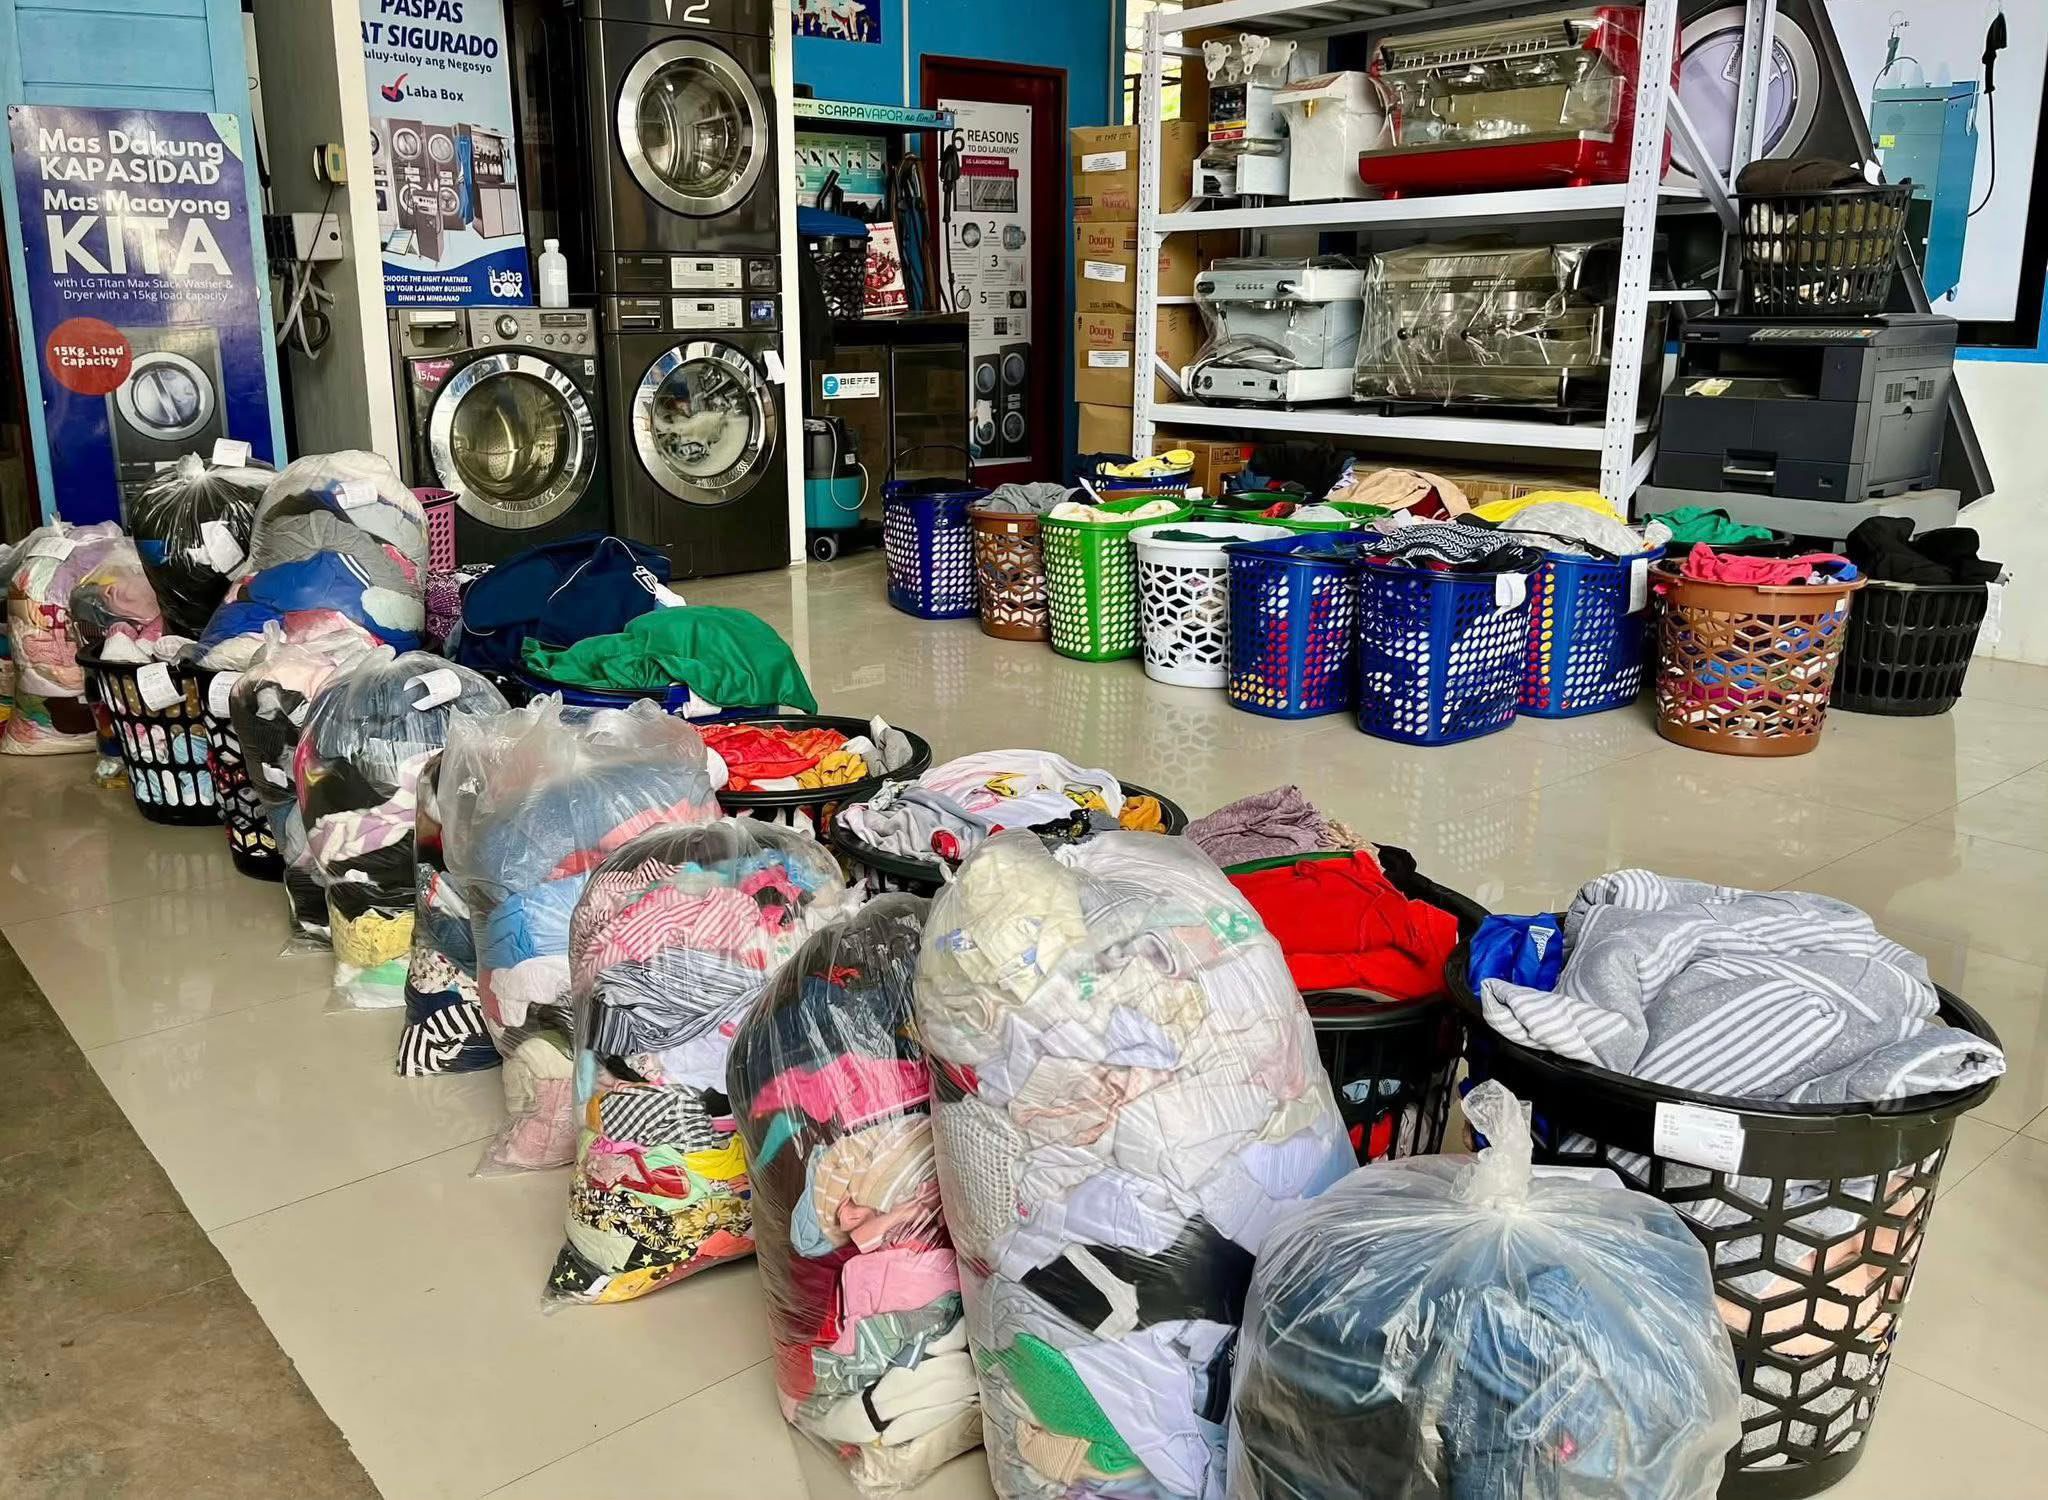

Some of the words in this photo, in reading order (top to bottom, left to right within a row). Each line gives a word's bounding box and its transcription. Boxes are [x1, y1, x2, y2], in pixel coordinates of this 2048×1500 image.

[380, 0, 463, 23] PASPAS
[387, 24, 498, 59] SIGURADO
[364, 49, 422, 66] uluy-tuloy
[425, 56, 446, 70] ang
[448, 58, 492, 75] Negosyo
[406, 85, 437, 99] Laba
[440, 88, 464, 102] Box
[818, 103, 902, 121] SCARPAVAPOR
[39, 128, 102, 153] Mas
[108, 130, 224, 165] Dakung
[952, 128, 965, 152] 6
[967, 129, 1019, 145] REASONS
[968, 144, 977, 153] TO
[977, 145, 988, 153] DO
[989, 146, 1019, 154] LAUNDRY
[40, 156, 220, 185] KAPASIDAD
[43, 189, 99, 211] Mas
[105, 190, 231, 220] Maayong
[952, 224, 957, 237] 1
[988, 221, 997, 234] 2
[46, 215, 234, 276] KITA
[991, 255, 998, 267] 3
[422, 275, 441, 283] RIGHT
[492, 269, 522, 282] Laba
[54, 278, 78, 288] with
[81, 279, 95, 288] LG
[98, 278, 125, 288] Titan
[127, 279, 150, 288] Max
[153, 278, 179, 289] Stack
[183, 278, 222, 289] Washer
[225, 279, 234, 289] &
[415, 285, 443, 293] LAUNDRY
[444, 285, 472, 293] BUSINESS
[64, 290, 94, 302] Dryer
[96, 290, 120, 300] with
[122, 292, 129, 300] a
[132, 290, 158, 302] 15kg
[160, 290, 183, 300] load
[186, 290, 228, 302] capacity
[980, 291, 987, 303] 5
[1089, 325, 1115, 338] Downy
[53, 346, 88, 358] 15Kg.
[92, 346, 124, 356] Load
[61, 356, 119, 368] Capacity
[840, 376, 877, 385] BIEFFE
